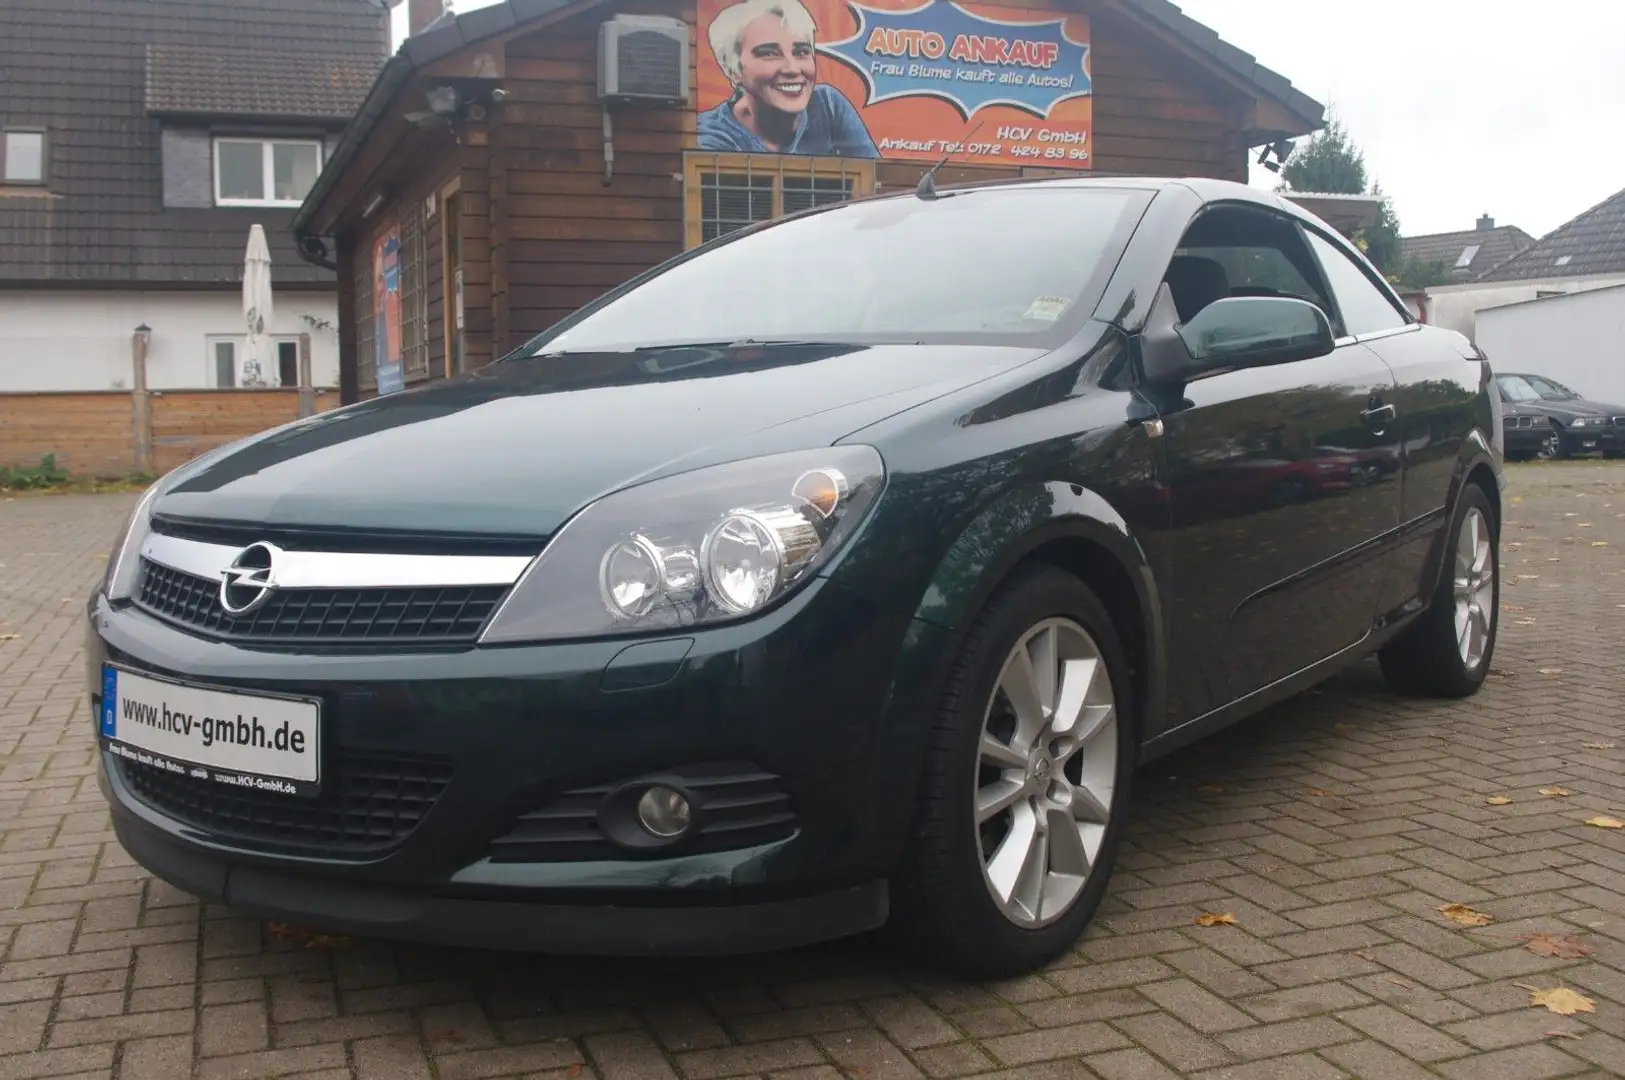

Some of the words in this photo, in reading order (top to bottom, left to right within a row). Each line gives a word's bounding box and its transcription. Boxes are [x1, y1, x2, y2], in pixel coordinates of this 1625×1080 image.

[865, 27, 945, 59] AUTO
[948, 34, 1059, 68] ANKAUF
[871, 61, 904, 76] Frau
[909, 63, 952, 79] Blume
[956, 67, 996, 82] kauft
[999, 71, 1024, 85] alle
[1027, 72, 1074, 88] Autos!
[996, 126, 1032, 140] HCV
[1037, 128, 1086, 144] GmbH
[879, 137, 936, 151] Ankauf
[967, 142, 1002, 155] 0172
[1010, 144, 1040, 158] 424
[122, 697, 305, 754] www.hcv-gmbh.de
[214, 773, 297, 794] www.HCV-GmbH.de
